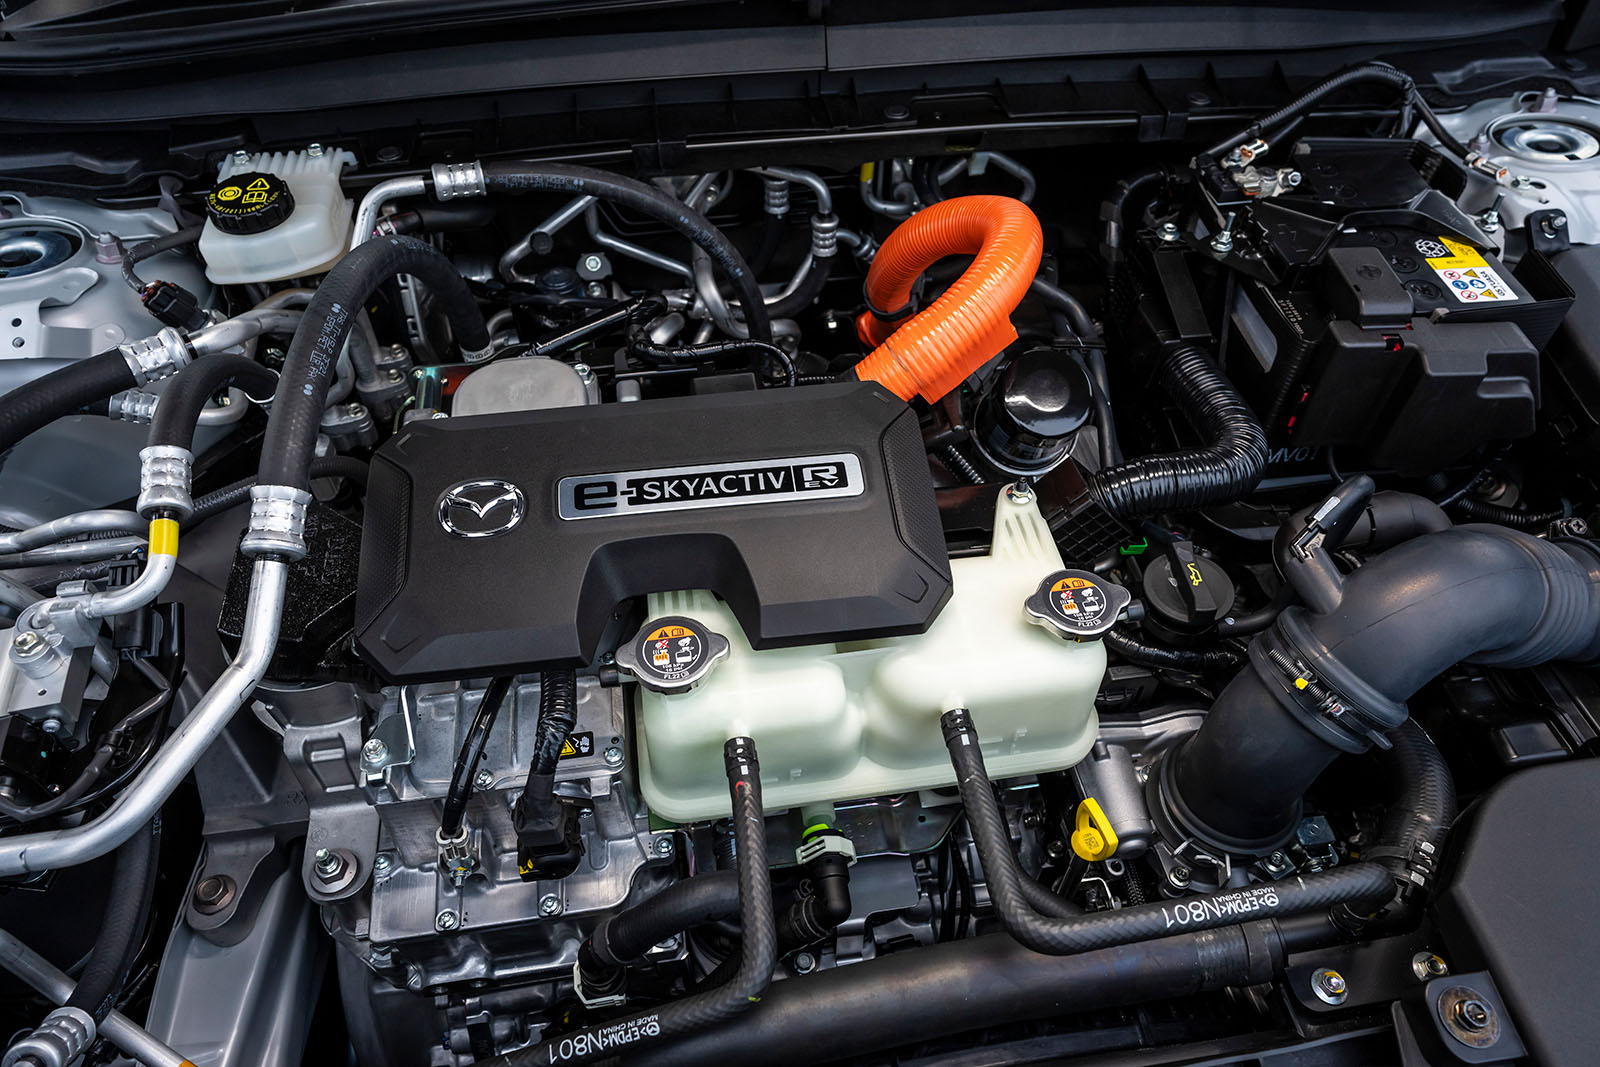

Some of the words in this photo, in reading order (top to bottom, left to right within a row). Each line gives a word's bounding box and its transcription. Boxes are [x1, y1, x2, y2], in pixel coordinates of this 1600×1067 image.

[804, 479, 840, 489] EV
[1252, 886, 1275, 896] MADE
[1216, 892, 1242, 902] CHINA
[1161, 897, 1222, 928] N801
[627, 1020, 636, 1028] IN
[636, 1014, 659, 1026] MADE
[602, 1023, 627, 1035] CHINA
[549, 1029, 603, 1064] N801
